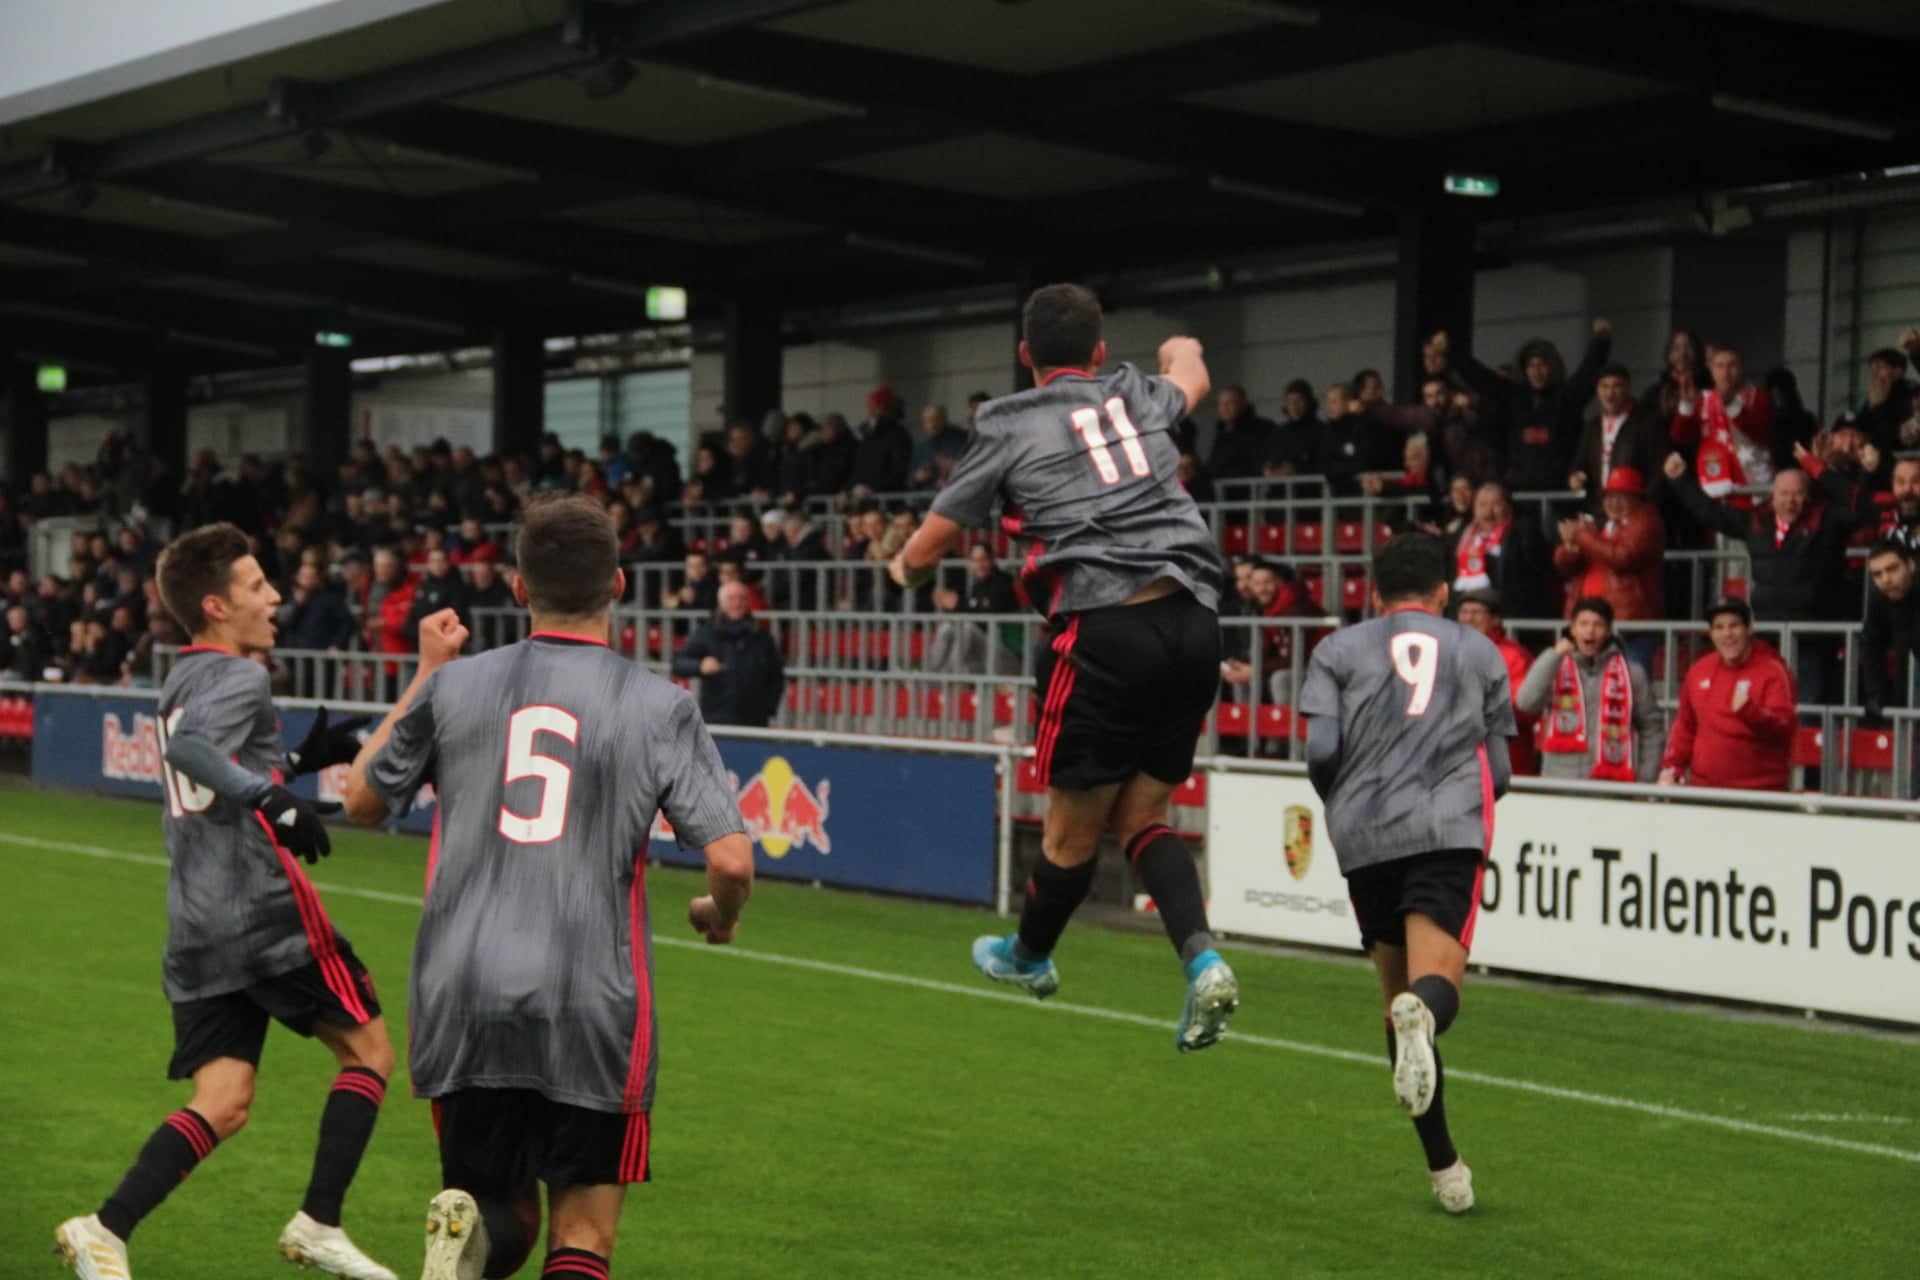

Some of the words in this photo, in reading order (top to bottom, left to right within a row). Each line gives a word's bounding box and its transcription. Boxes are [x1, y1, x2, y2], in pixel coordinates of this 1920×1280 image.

[1070, 396, 1151, 484] 11
[1390, 630, 1440, 716] 9
[499, 704, 580, 845] 5
[1516, 842, 1580, 921] für
[1592, 847, 1789, 946] Talente.
